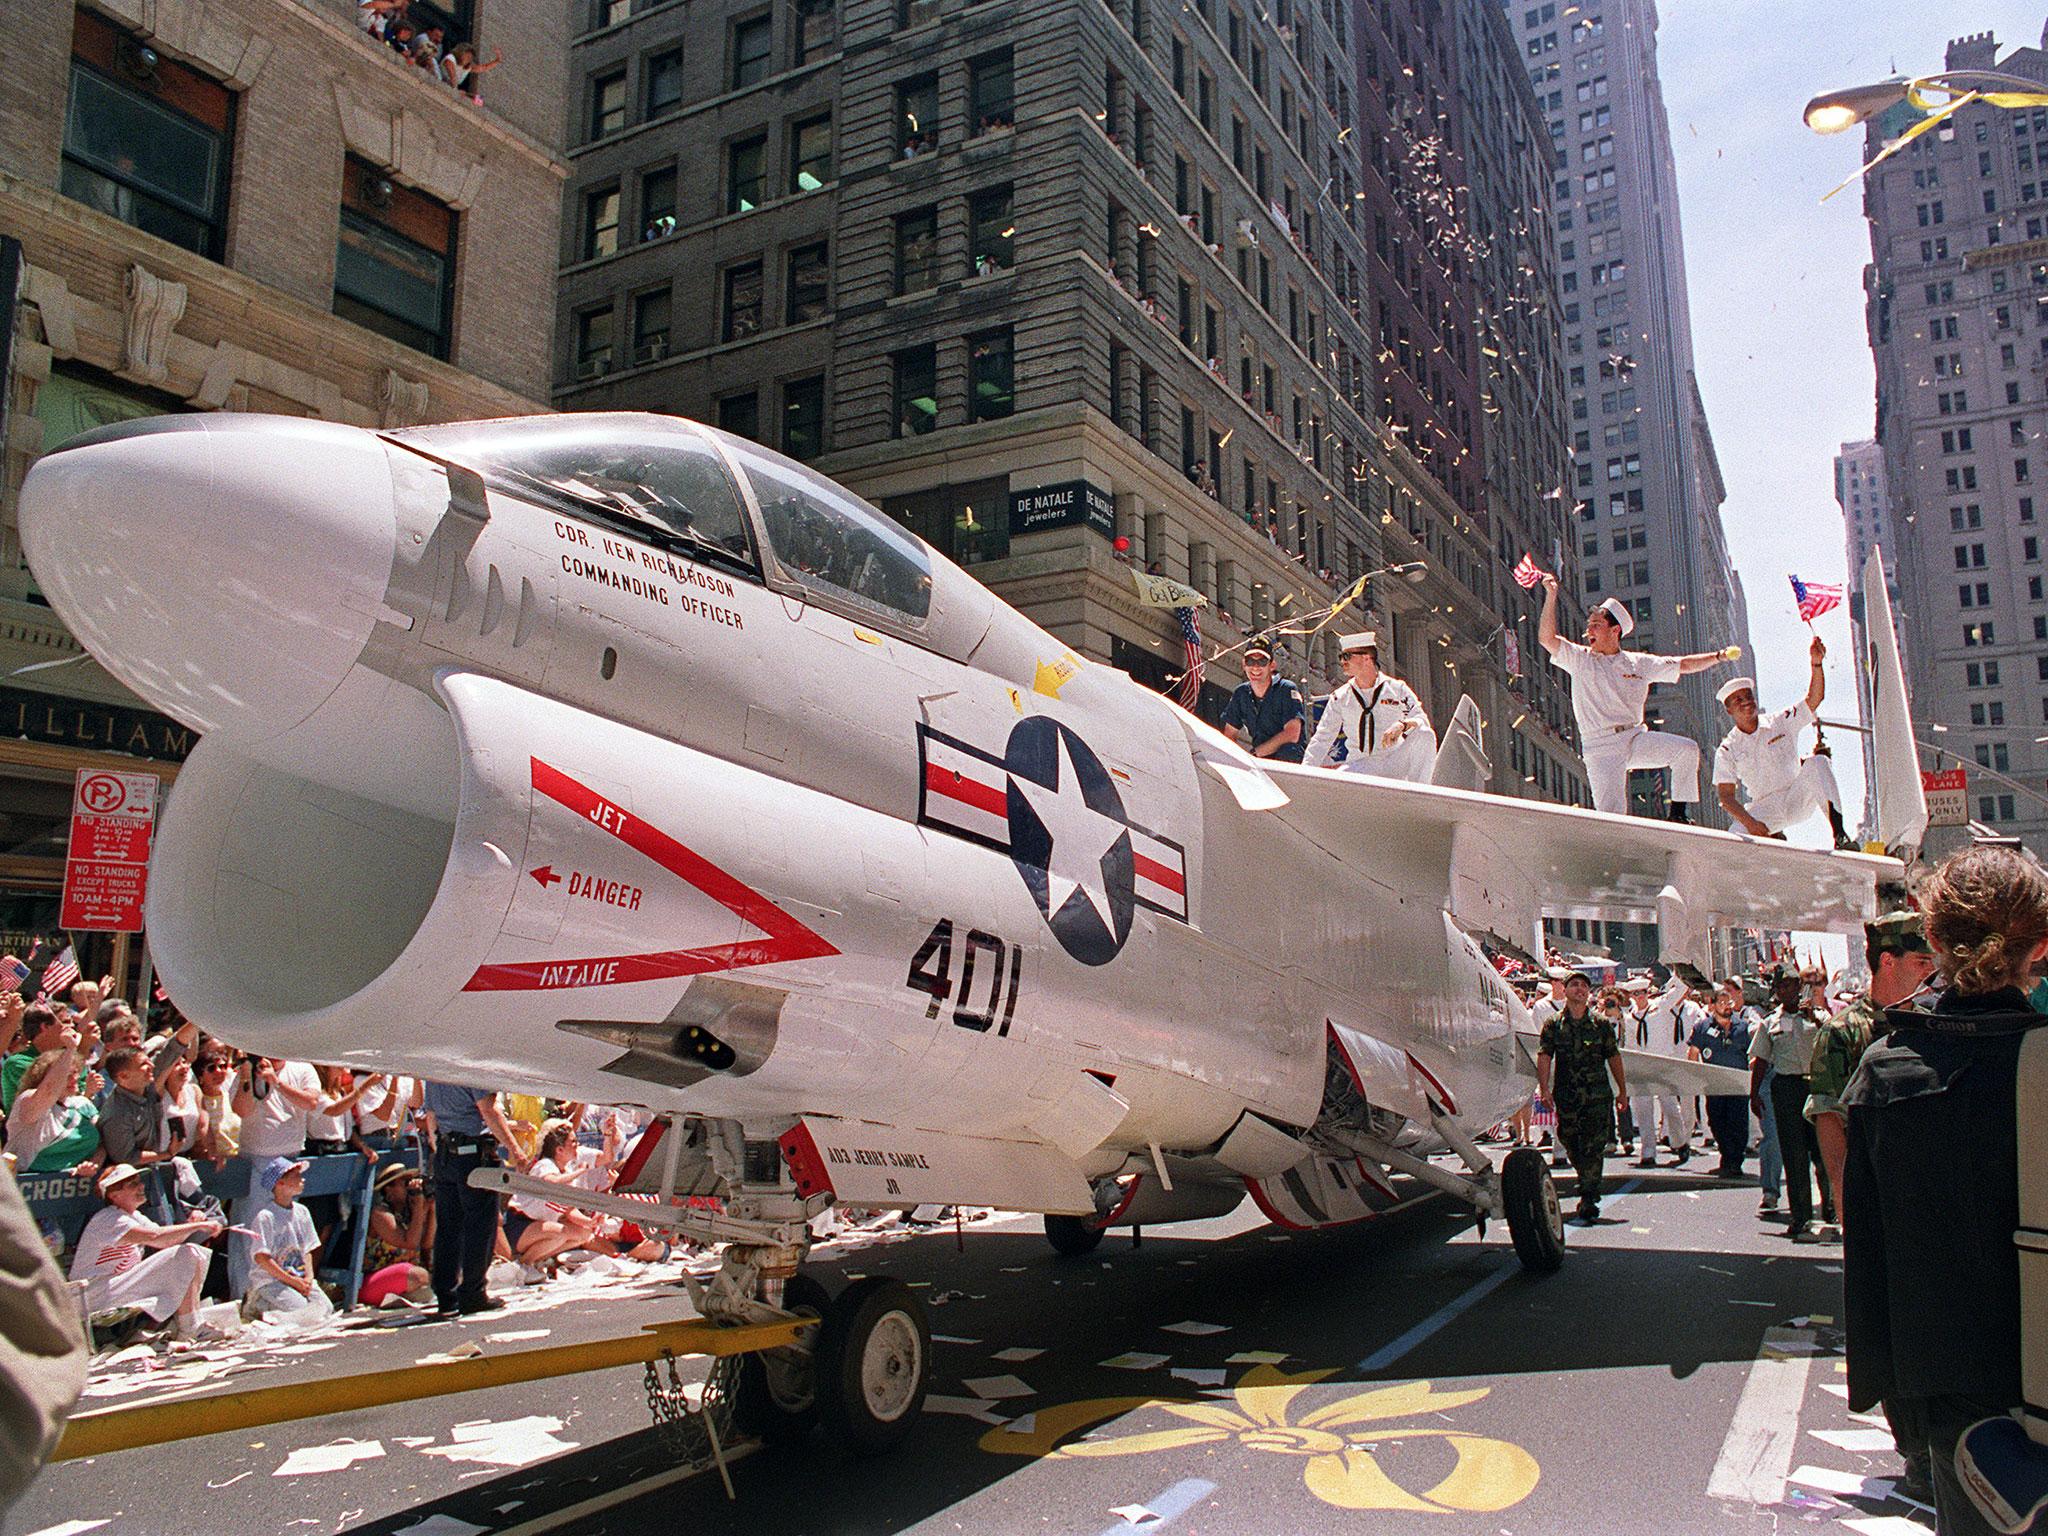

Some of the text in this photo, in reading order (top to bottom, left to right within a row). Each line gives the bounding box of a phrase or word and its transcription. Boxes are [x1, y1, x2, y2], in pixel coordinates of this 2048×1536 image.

[1018, 490, 1074, 513] DE NATALE
[1024, 508, 1067, 526] jewelers
[555, 521, 595, 550] CDR.
[641, 552, 735, 599] RICHARDSON
[561, 554, 744, 630] COMMANDING OFFICER
[1932, 780, 1961, 789] LANE
[589, 801, 628, 835] JET
[1934, 806, 1962, 815] ONLY
[80, 815, 146, 830] NO STANDING
[74, 864, 141, 879] NO STANDING
[76, 877, 105, 886] EXCEPT
[569, 870, 643, 912] DANGER
[539, 961, 620, 987] INTAKE
[906, 917, 1023, 1038] 401
[1926, 1018, 1977, 1032] Canon
[827, 1146, 930, 1170] AD3 JERRY SAMPLE
[20, 1176, 92, 1200] CROSS
[886, 1178, 902, 1195] JR
